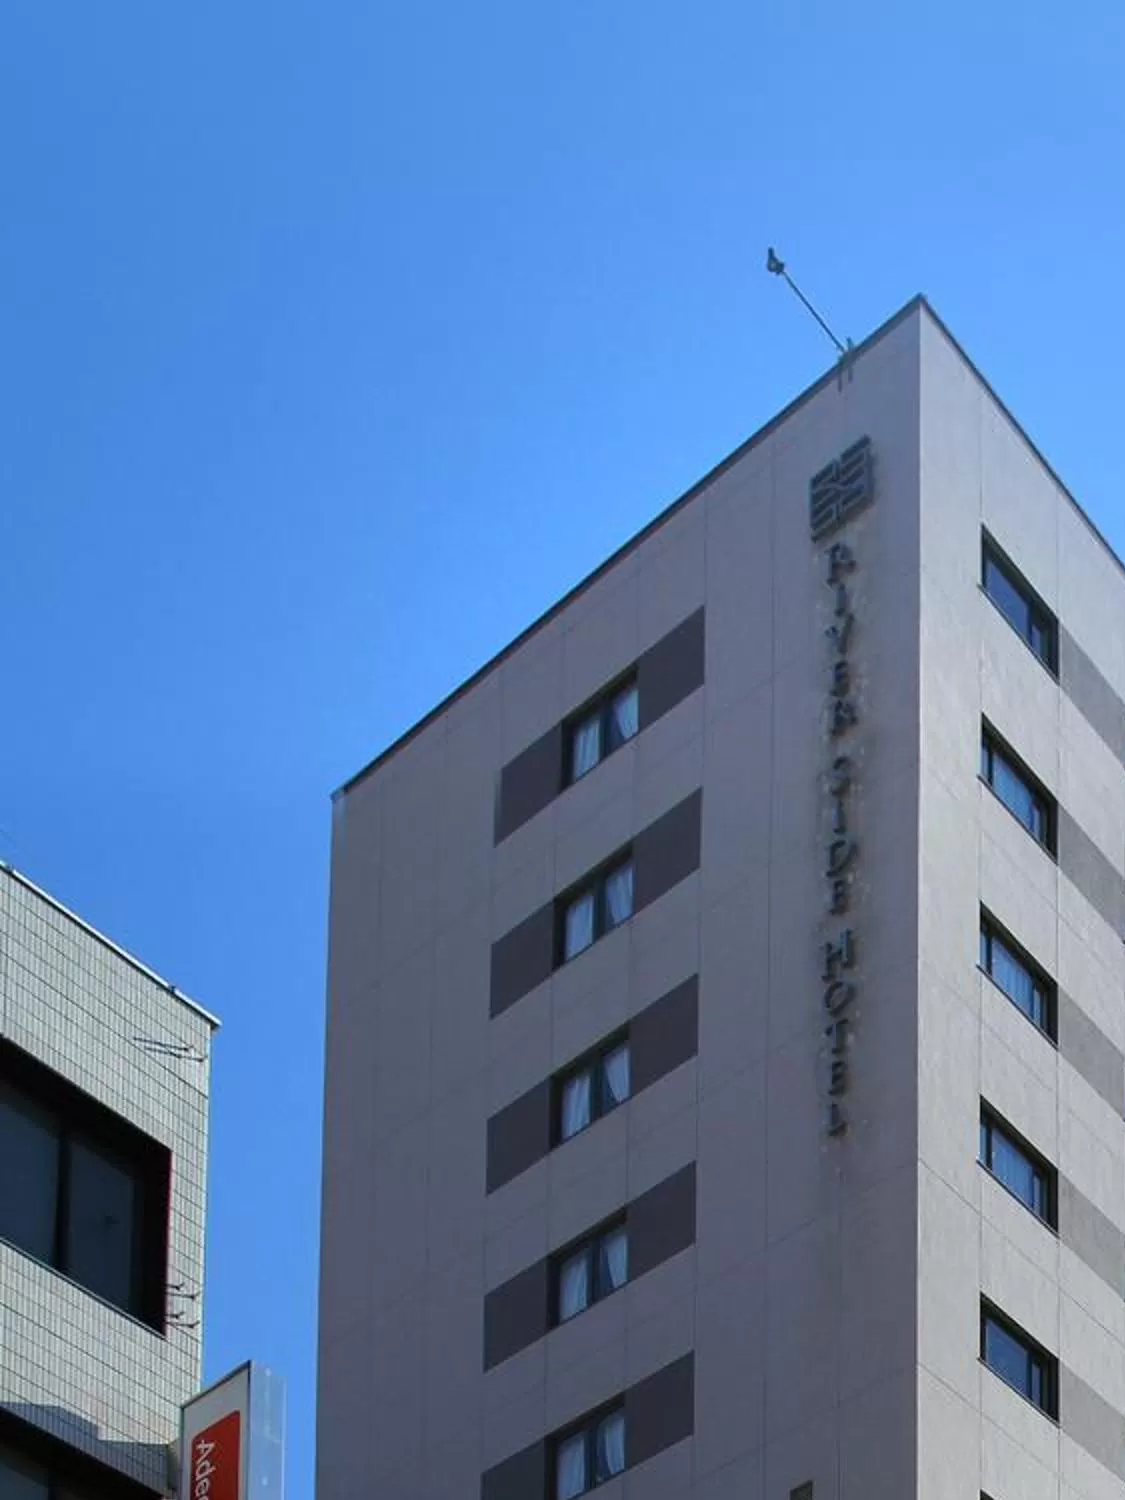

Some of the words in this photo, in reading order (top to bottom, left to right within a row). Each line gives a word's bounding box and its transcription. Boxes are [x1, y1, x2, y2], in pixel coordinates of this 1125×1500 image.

[825, 543, 857, 736] RIVER
[826, 756, 858, 916] SIDE
[822, 928, 857, 1137] HOTEL
